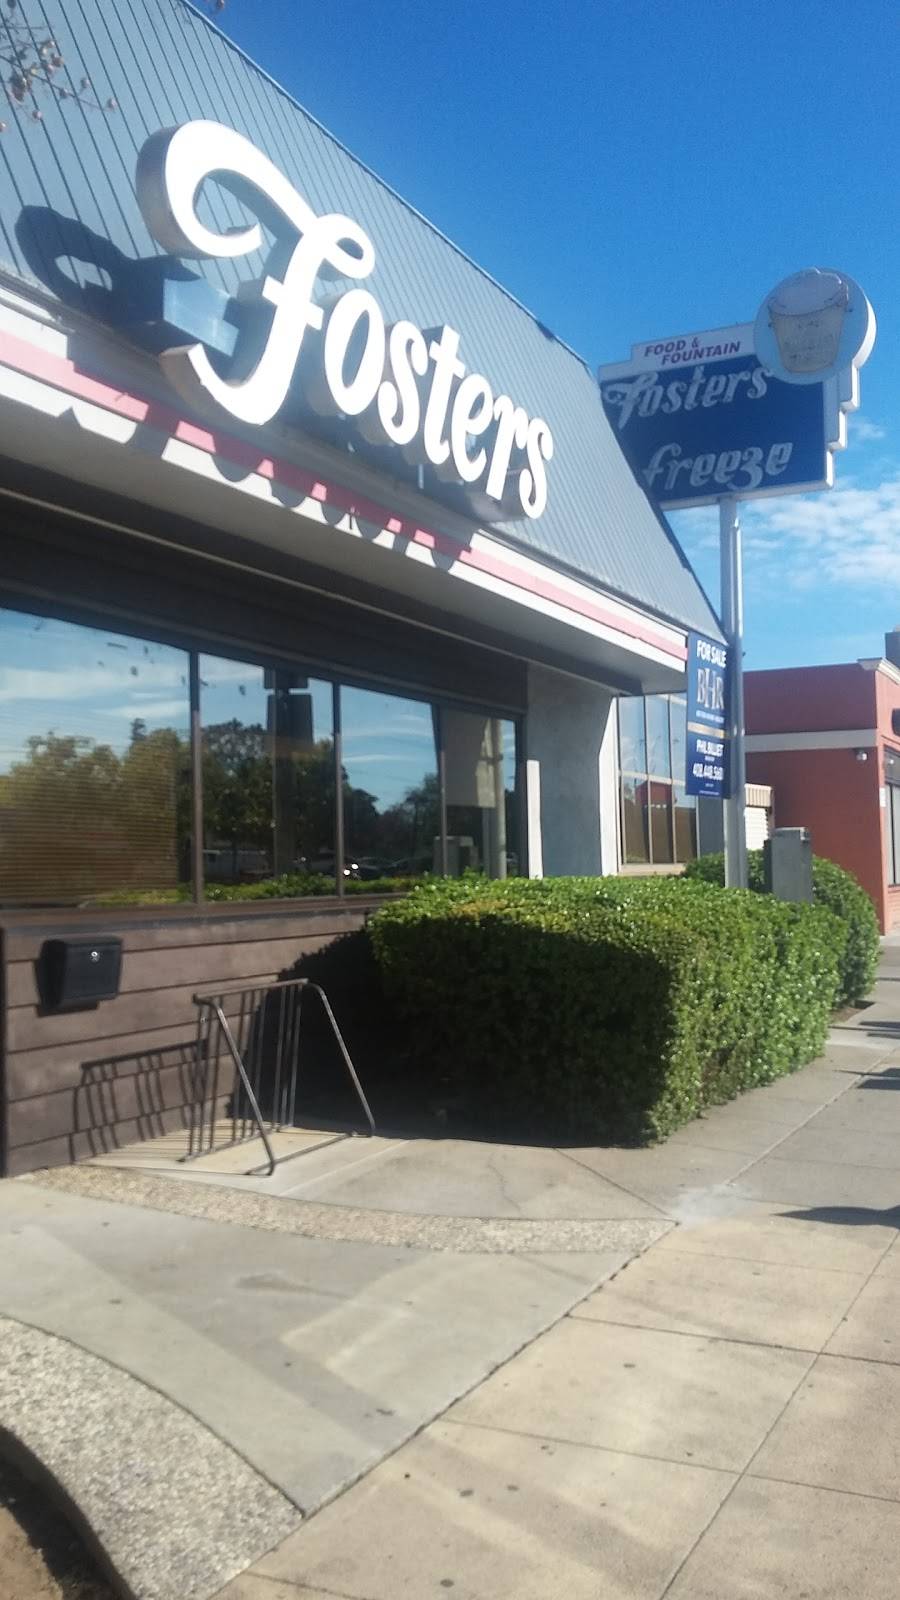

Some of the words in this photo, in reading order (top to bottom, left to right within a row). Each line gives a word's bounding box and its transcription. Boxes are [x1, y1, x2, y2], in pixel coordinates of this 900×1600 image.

[160, 118, 554, 520] Fosters
[644, 339, 686, 358] FOOD
[691, 337, 699, 349] &
[661, 341, 741, 366] FOUNTAIN
[697, 640, 711, 662] FOR
[711, 646, 727, 668] SALE
